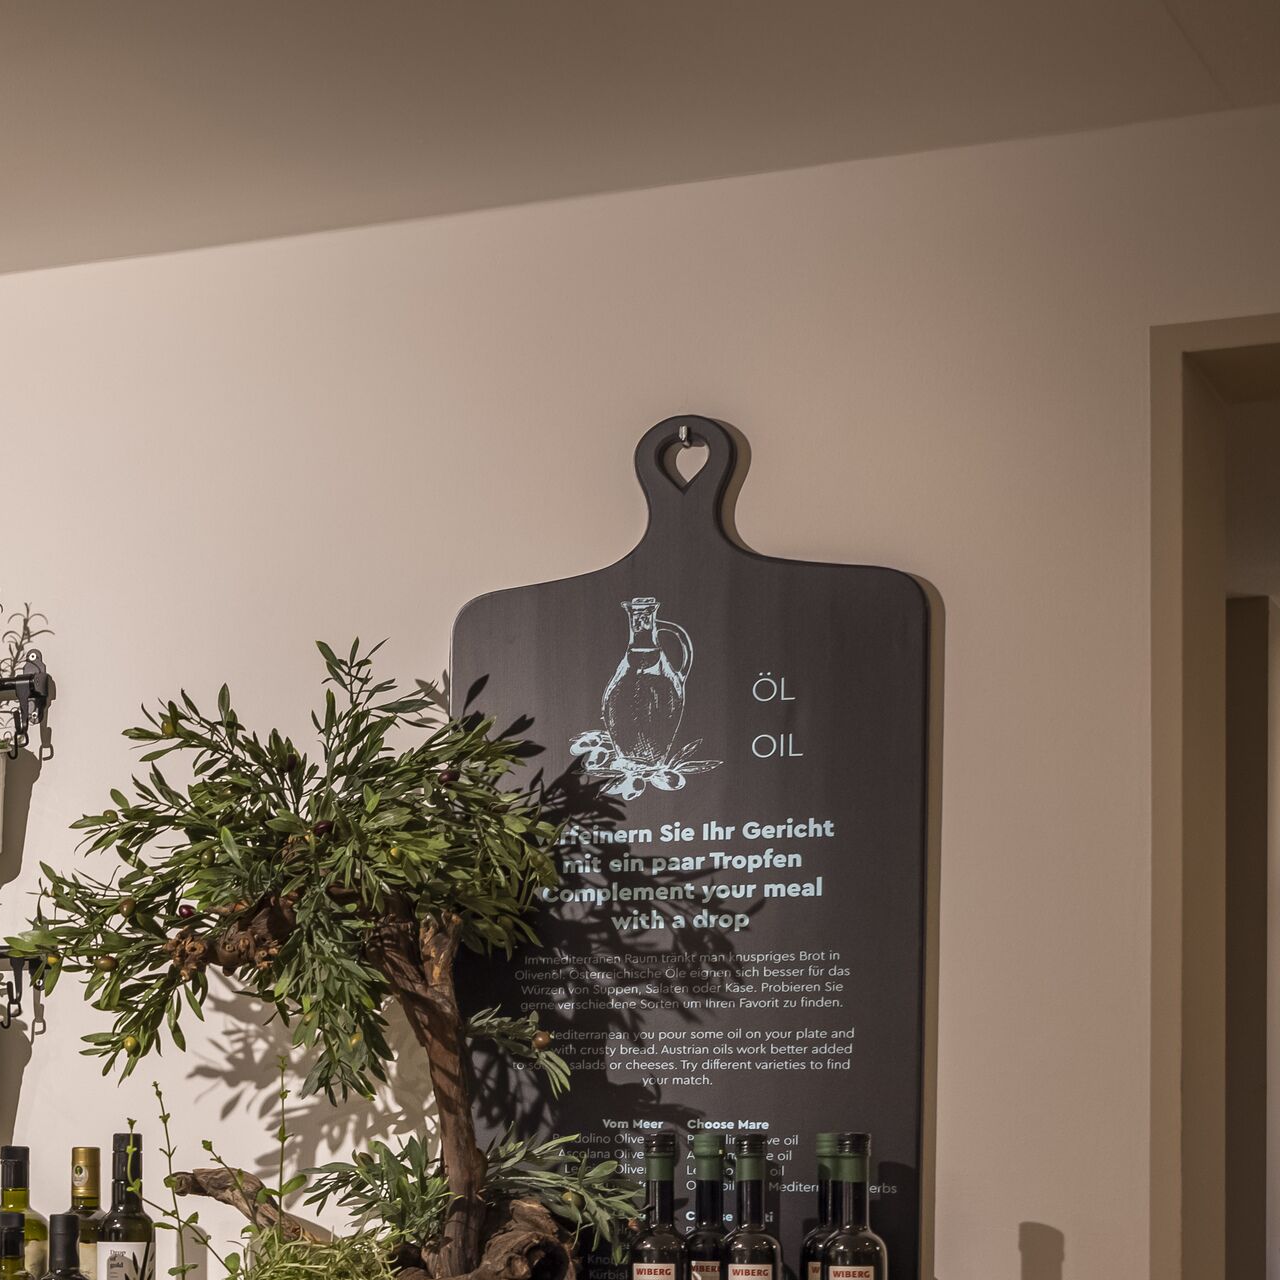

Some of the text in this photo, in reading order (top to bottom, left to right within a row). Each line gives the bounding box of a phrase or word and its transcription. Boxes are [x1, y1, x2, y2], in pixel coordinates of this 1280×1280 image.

[752, 671, 795, 701] ÖL
[751, 733, 803, 758] OIL
[539, 817, 834, 846] rfeinern Sie Ihr Gericht
[562, 848, 802, 875] mit ein paar Tropfen
[542, 876, 822, 907] Complement your meal
[610, 908, 749, 931] with a drop
[633, 1031, 655, 1041] you
[658, 1031, 687, 1041] pour
[690, 1031, 724, 1039] some
[727, 1028, 742, 1039] oil
[745, 1031, 761, 1039] on
[765, 1030, 792, 1041] your
[796, 1027, 827, 1040] plate
[831, 1027, 855, 1038] and
[580, 1045, 616, 1057] crusty
[620, 1043, 657, 1055] bread.
[660, 1044, 709, 1054] Austrian
[712, 1043, 733, 1054] oils
[736, 1043, 766, 1054] work
[770, 1043, 808, 1054] better
[811, 1043, 852, 1054] added
[570, 1059, 604, 1070] salads
[625, 1059, 677, 1069] cheeses.
[680, 1059, 698, 1072] Try
[701, 1058, 752, 1069] different
[754, 1059, 806, 1070] varieties
[810, 1060, 823, 1069] to
[826, 1058, 850, 1069] find
[642, 1074, 713, 1086] your match.
[602, 1119, 664, 1128] Vom Meer
[687, 1118, 769, 1129] Choose Mare
[635, 1268, 672, 1276] WIBERG
[732, 1268, 769, 1277] WIBERG
[833, 1270, 870, 1278] WIBERG
